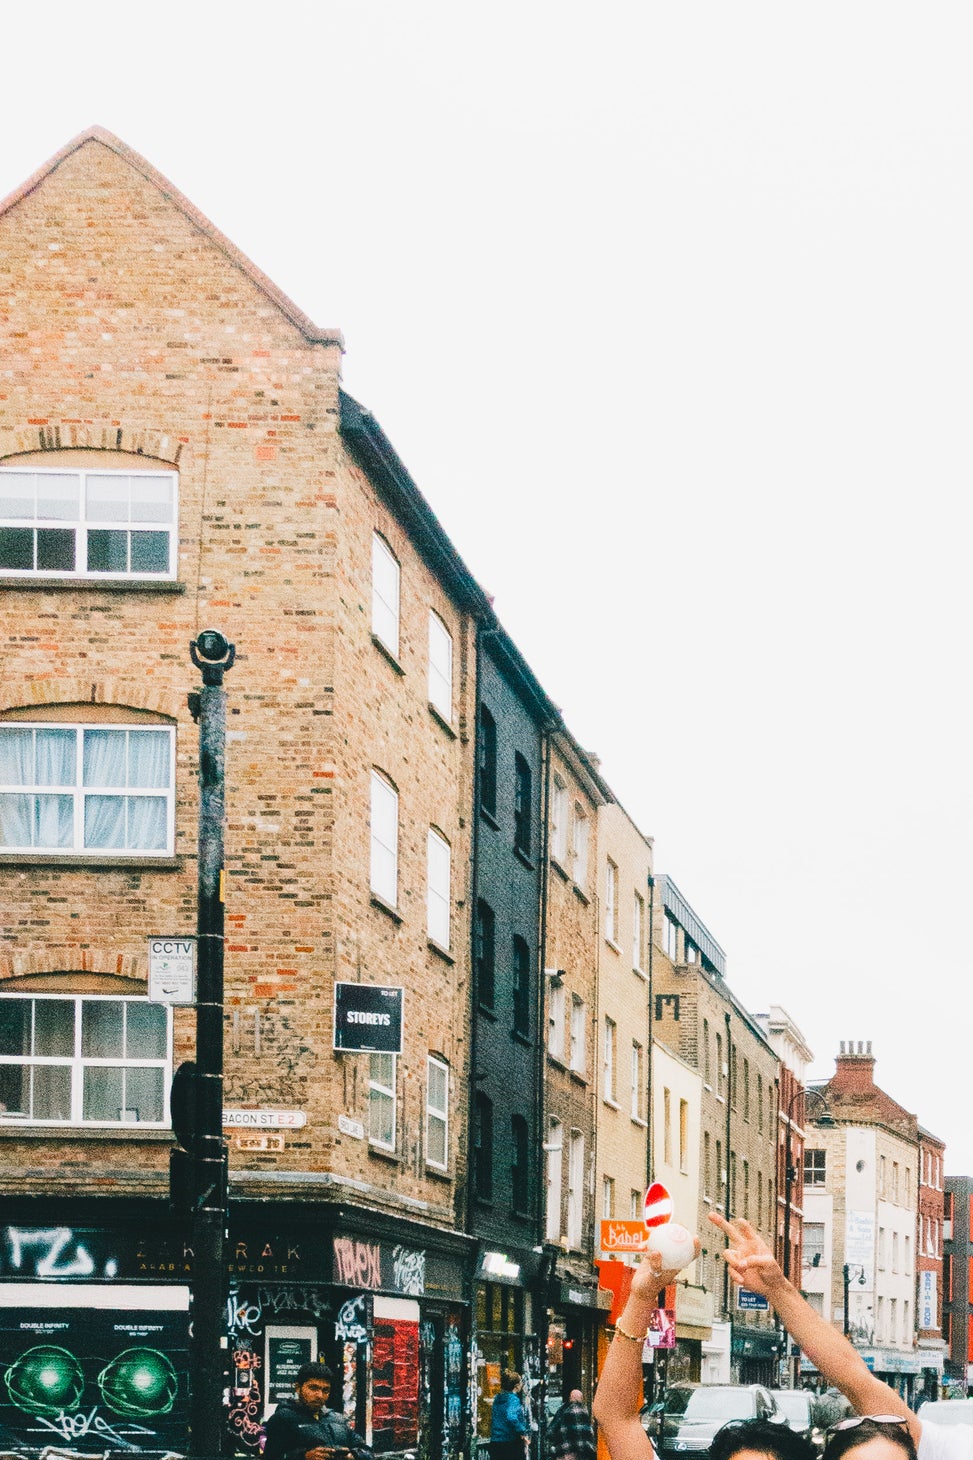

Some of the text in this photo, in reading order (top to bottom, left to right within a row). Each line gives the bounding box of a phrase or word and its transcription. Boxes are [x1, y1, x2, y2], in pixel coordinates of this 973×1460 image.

[152, 942, 192, 954] CCTV
[346, 1010, 391, 1026] STOREYS
[222, 1114, 258, 1124] BACON
